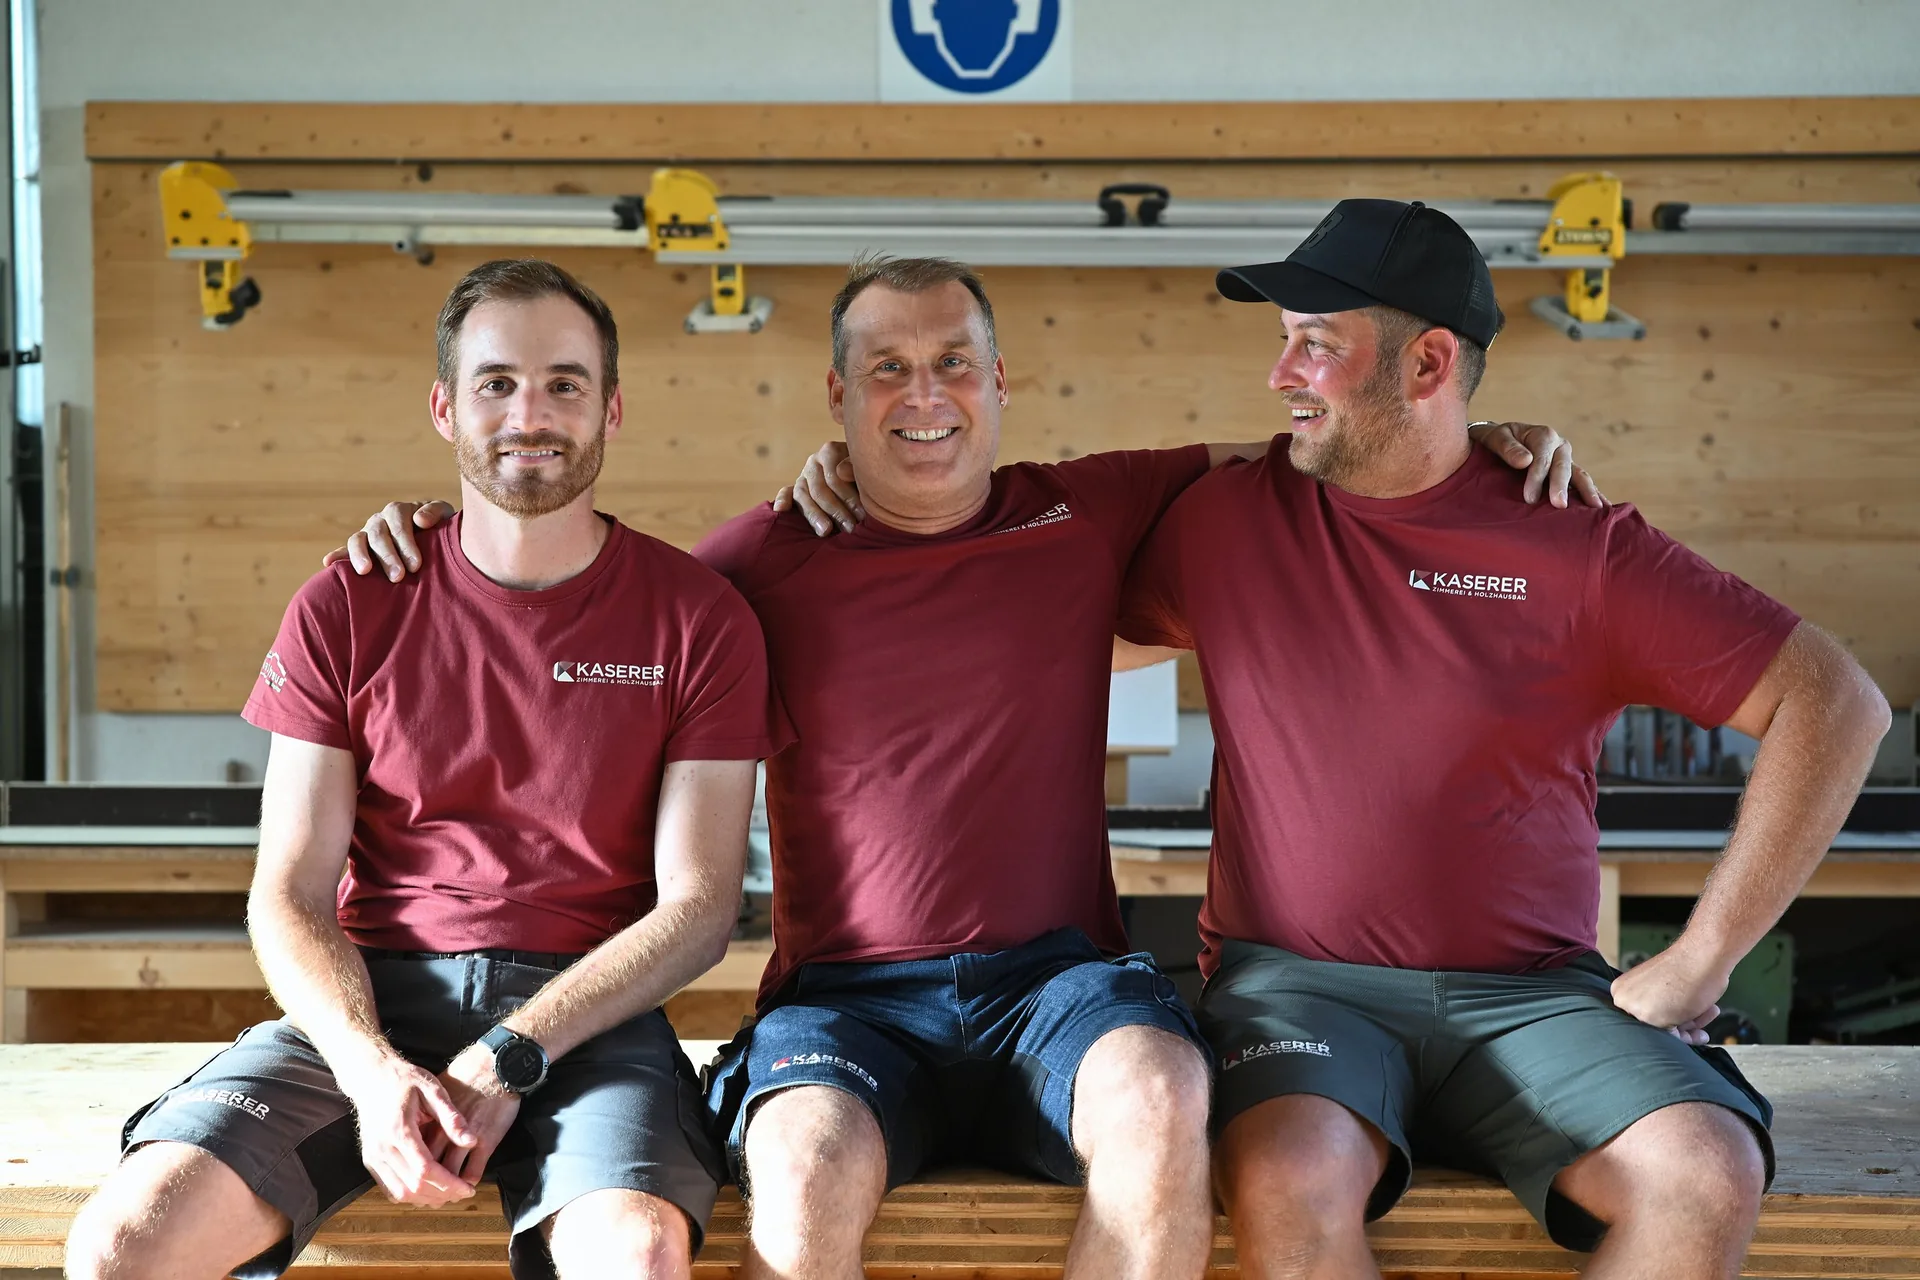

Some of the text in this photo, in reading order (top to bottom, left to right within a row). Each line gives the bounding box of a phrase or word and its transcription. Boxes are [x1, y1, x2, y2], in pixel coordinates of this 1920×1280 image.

[989, 526, 1020, 535] EREI
[1027, 514, 1072, 528] HOLZHAUSBAU
[1433, 572, 1527, 593] KASERER
[1432, 587, 1466, 596] ZIMMEREI
[1474, 591, 1527, 601] HOLZHAUSBAU
[576, 662, 665, 680] KASERER
[1243, 1041, 1330, 1058] KASERER
[186, 1089, 270, 1118] ASERER
